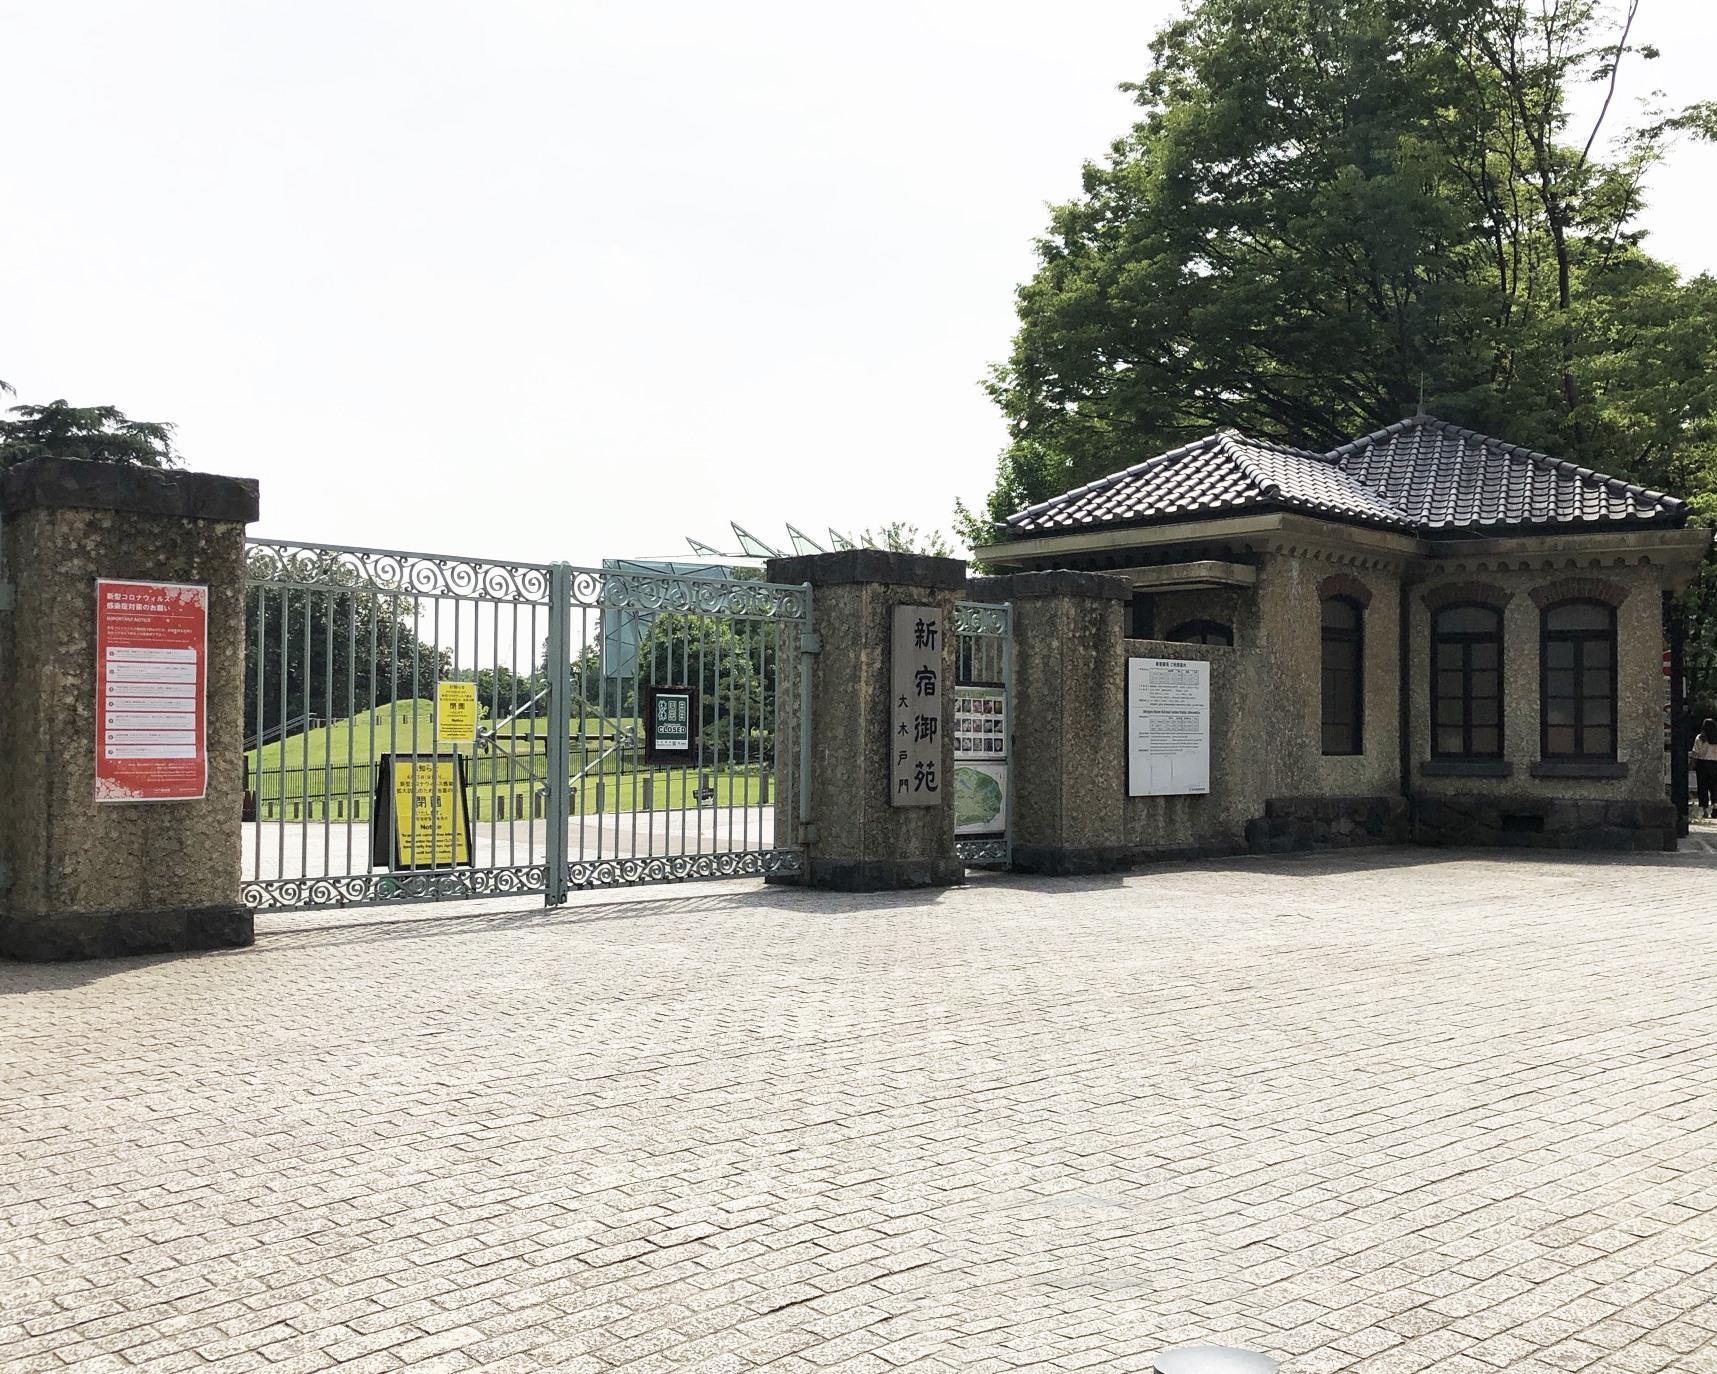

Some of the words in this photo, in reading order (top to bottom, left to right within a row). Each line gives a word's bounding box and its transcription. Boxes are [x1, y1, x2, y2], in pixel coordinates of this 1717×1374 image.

[106, 592, 171, 602] 新型コロナウィルス
[106, 602, 171, 612] 感染症対策のお願い
[914, 617, 939, 793] 新宿御苑
[898, 694, 909, 793] 大木戸門
